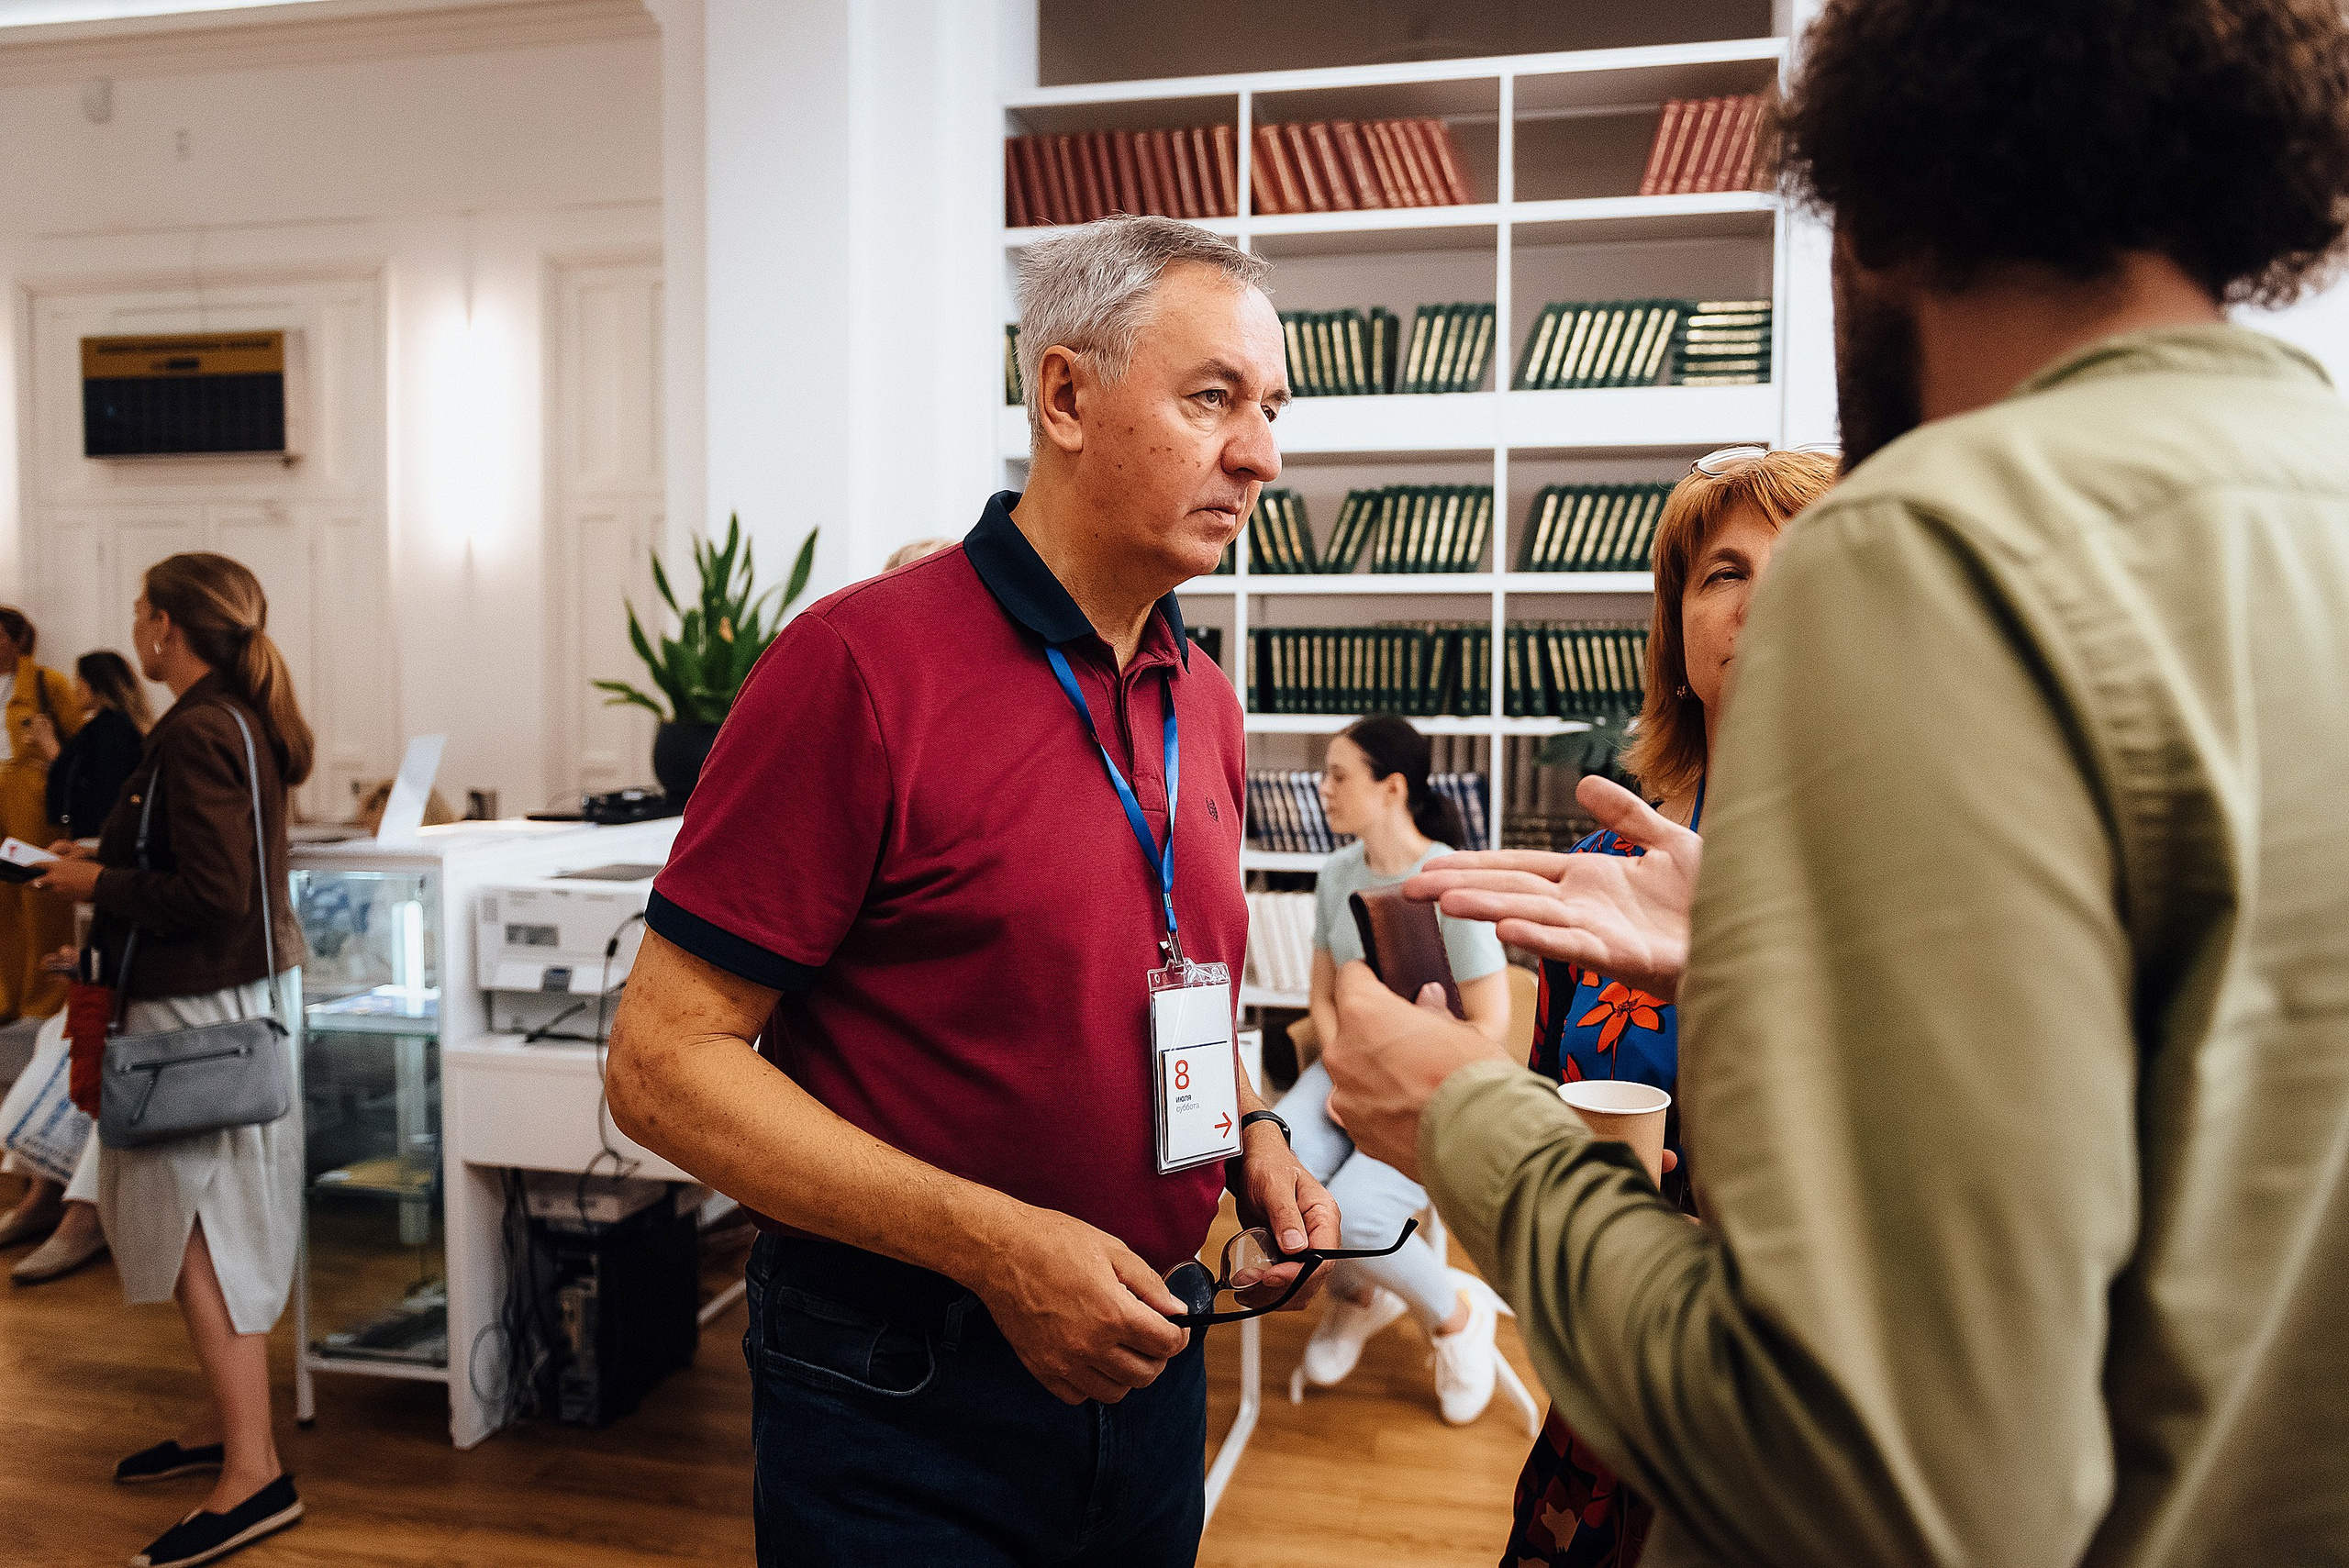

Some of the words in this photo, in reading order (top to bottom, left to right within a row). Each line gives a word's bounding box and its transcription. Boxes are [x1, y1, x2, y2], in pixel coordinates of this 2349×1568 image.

[1174, 1059, 1190, 1090] 8
[1175, 1095, 1192, 1103] июля
[1175, 1103, 1200, 1114] суббота
